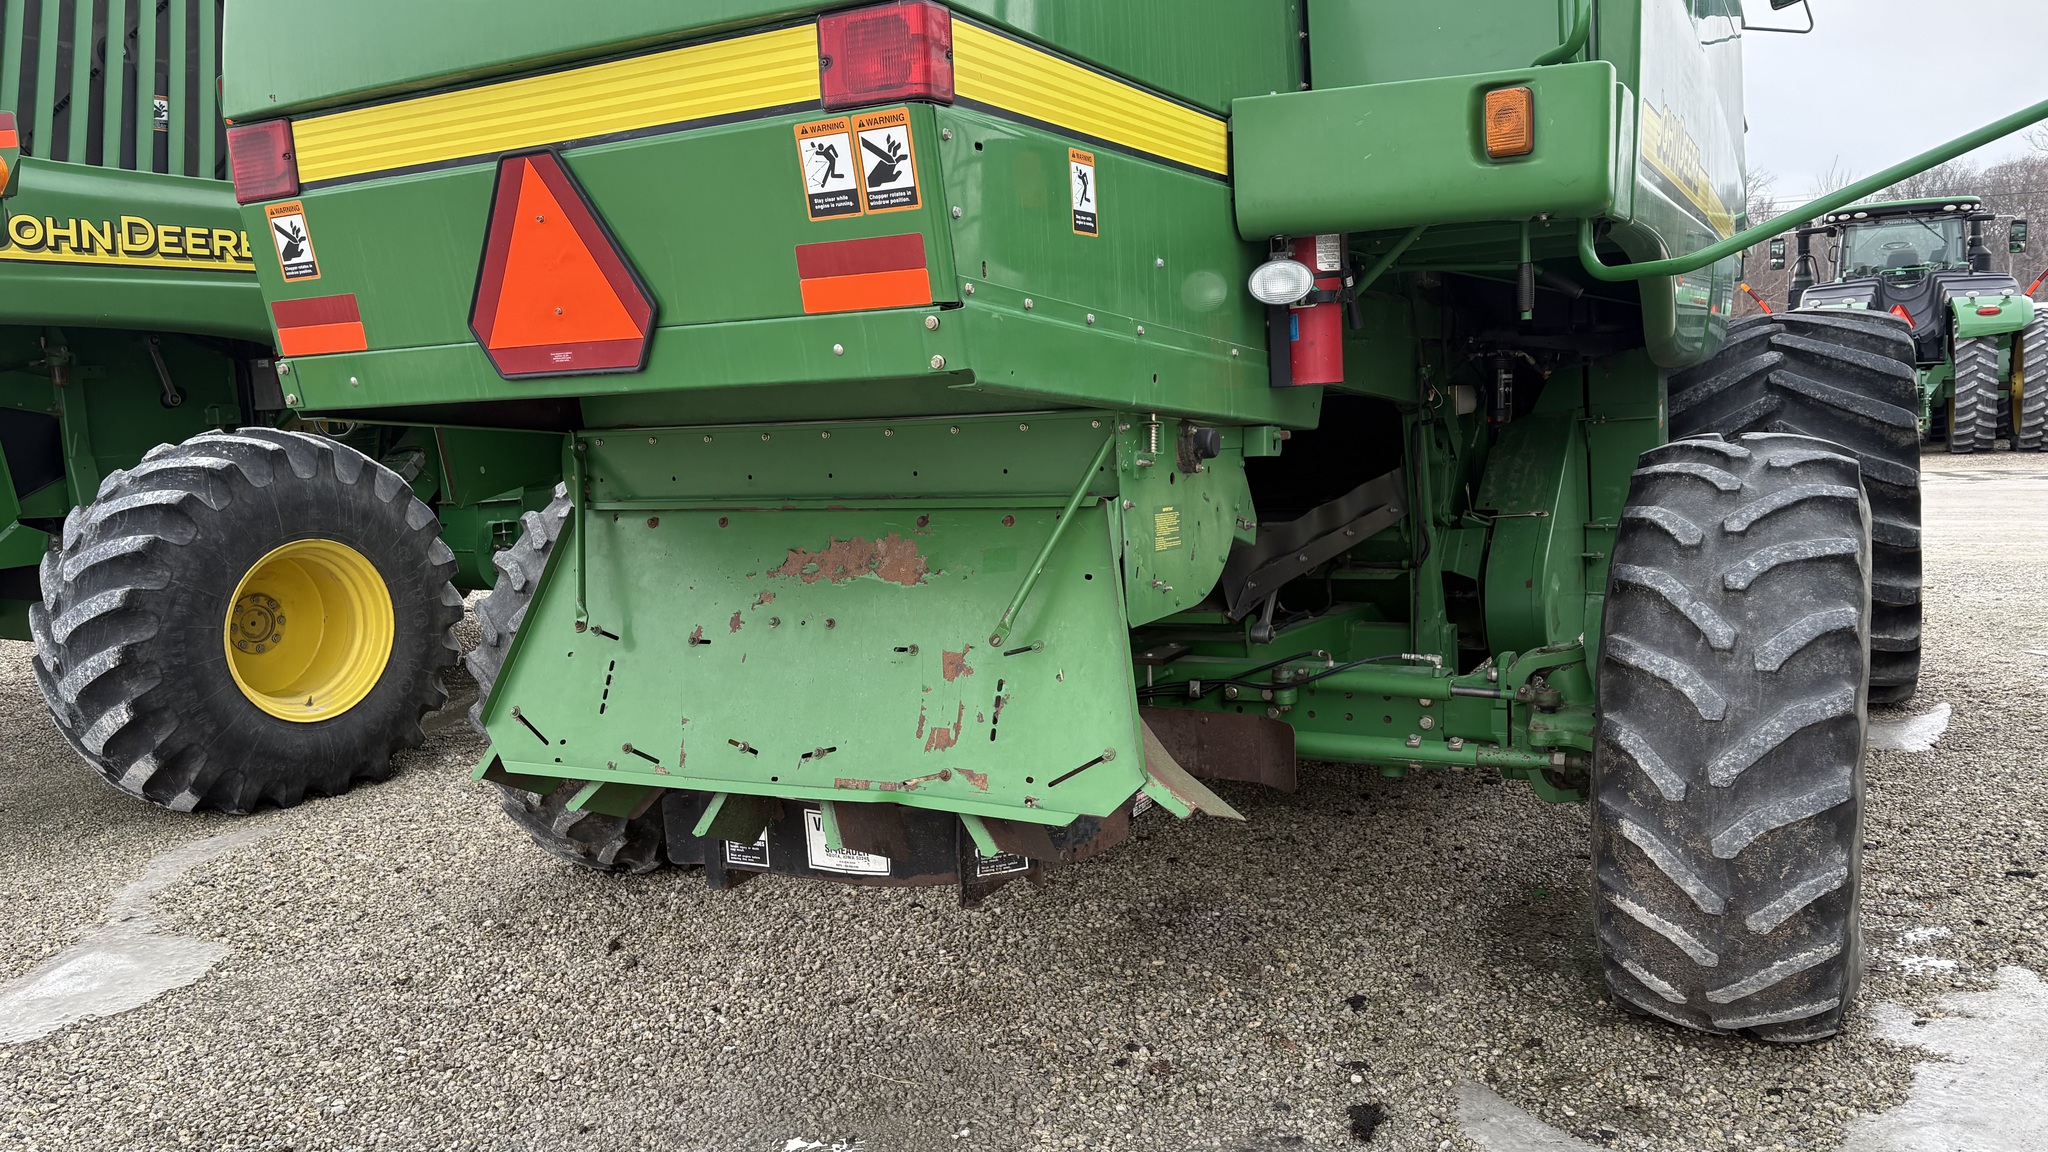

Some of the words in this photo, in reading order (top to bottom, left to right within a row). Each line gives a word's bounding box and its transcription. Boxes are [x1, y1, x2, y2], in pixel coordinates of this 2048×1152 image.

[865, 113, 905, 127] WARNING
[809, 121, 845, 133] WARNING
[275, 204, 300, 215] WARNING
[6, 213, 113, 251] OHN
